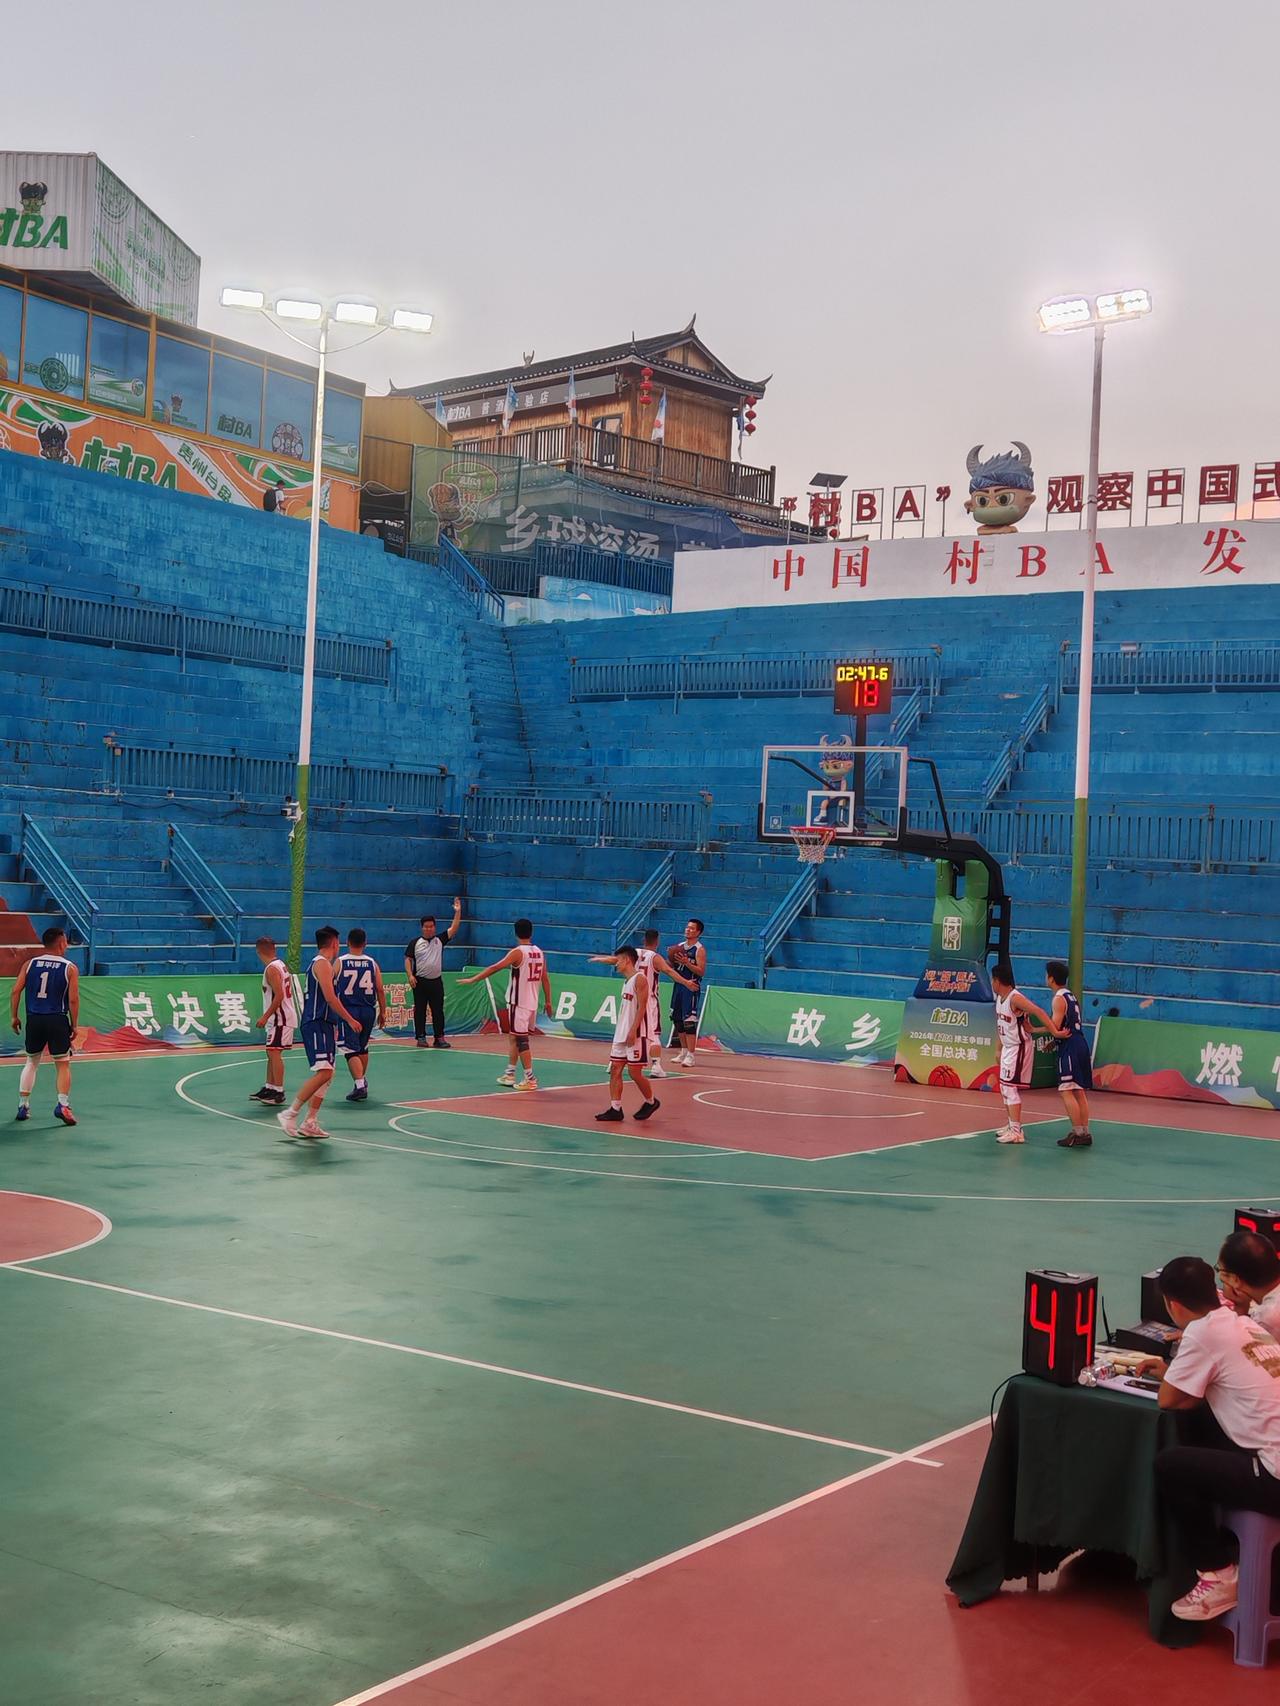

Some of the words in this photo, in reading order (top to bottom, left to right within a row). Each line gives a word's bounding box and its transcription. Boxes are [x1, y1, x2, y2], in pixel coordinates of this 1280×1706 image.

[217, 414, 253, 439] 村BA
[1200, 527, 1247, 575] 发
[836, 665, 889, 682] 02:47.6
[854, 680, 879, 707] 18
[37, 971, 49, 998] 1
[343, 970, 374, 995] 74
[527, 962, 543, 982] 15
[122, 990, 251, 1036] 总决赛
[930, 1007, 969, 1027] 村BA
[787, 1007, 881, 1051] 故乡
[920, 1043, 978, 1061] 全国总决赛
